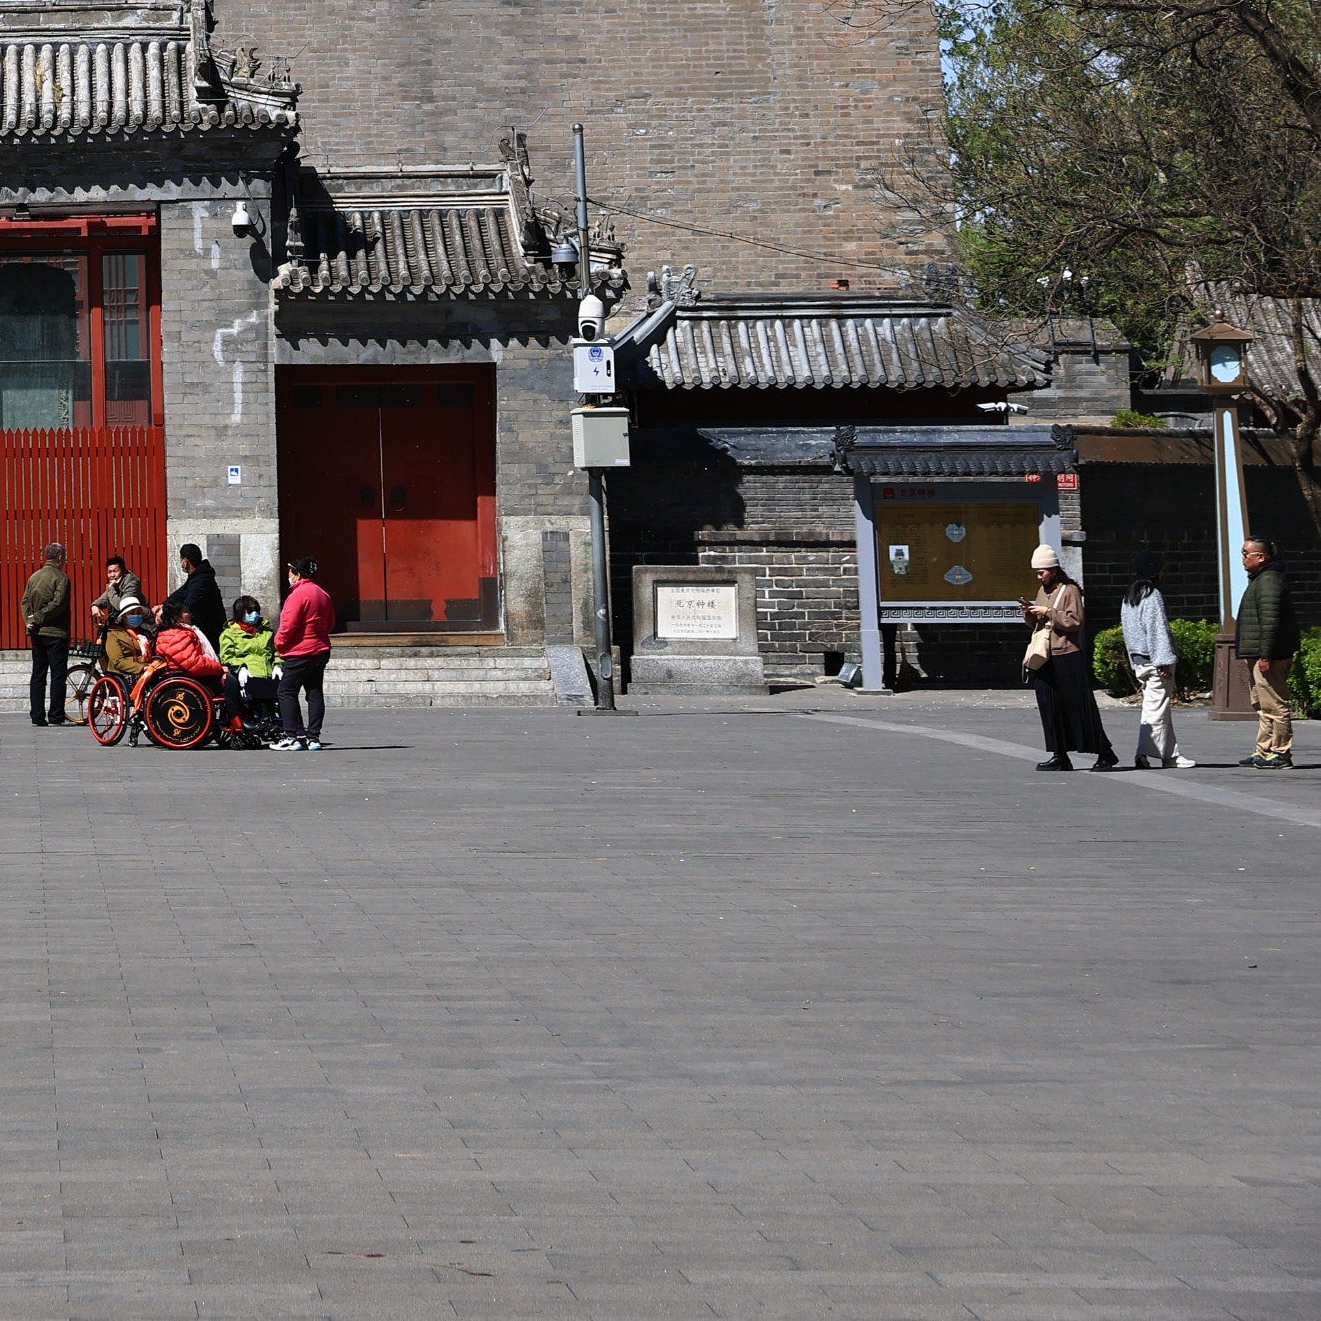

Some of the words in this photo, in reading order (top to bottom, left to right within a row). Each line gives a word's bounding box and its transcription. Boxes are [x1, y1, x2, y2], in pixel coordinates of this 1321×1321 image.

[899, 488, 935, 498] 北京钟楼
[675, 599, 717, 609] 北京钟楼
